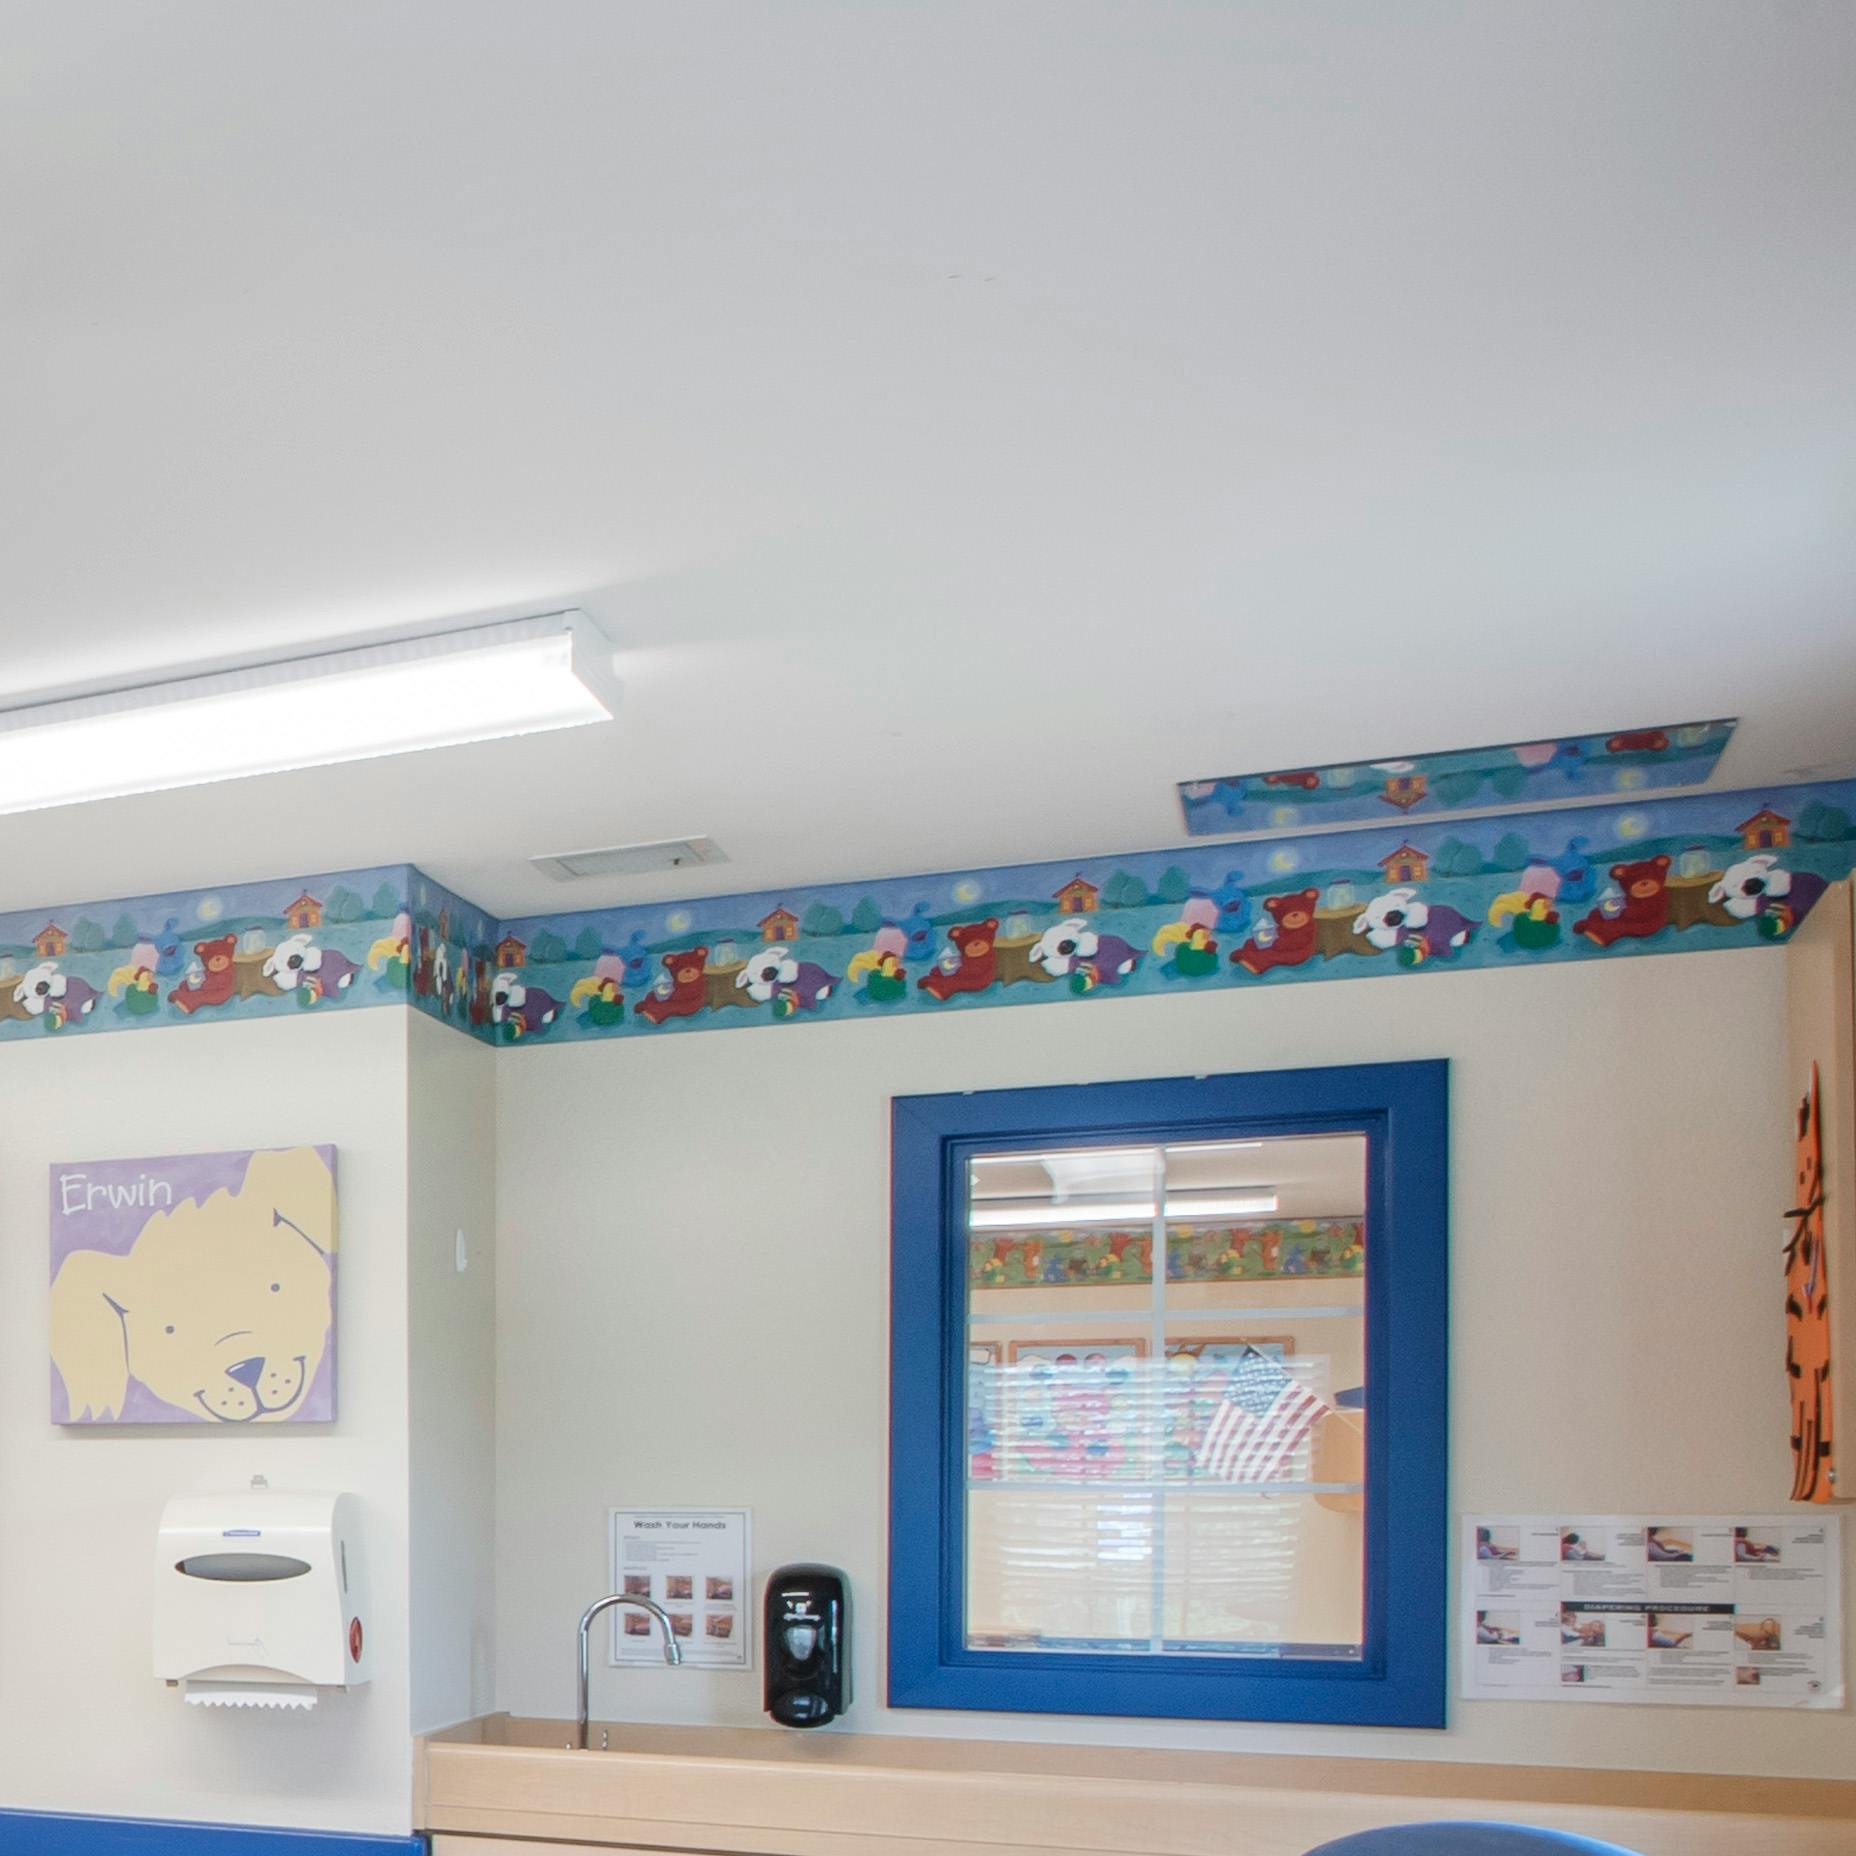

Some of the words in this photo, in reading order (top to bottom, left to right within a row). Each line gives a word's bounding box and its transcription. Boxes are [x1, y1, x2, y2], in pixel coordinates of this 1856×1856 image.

[59, 1173, 172, 1215] Erwin
[633, 1520, 662, 1529] Wash
[665, 1521, 690, 1529] Your
[692, 1520, 726, 1529] Hands
